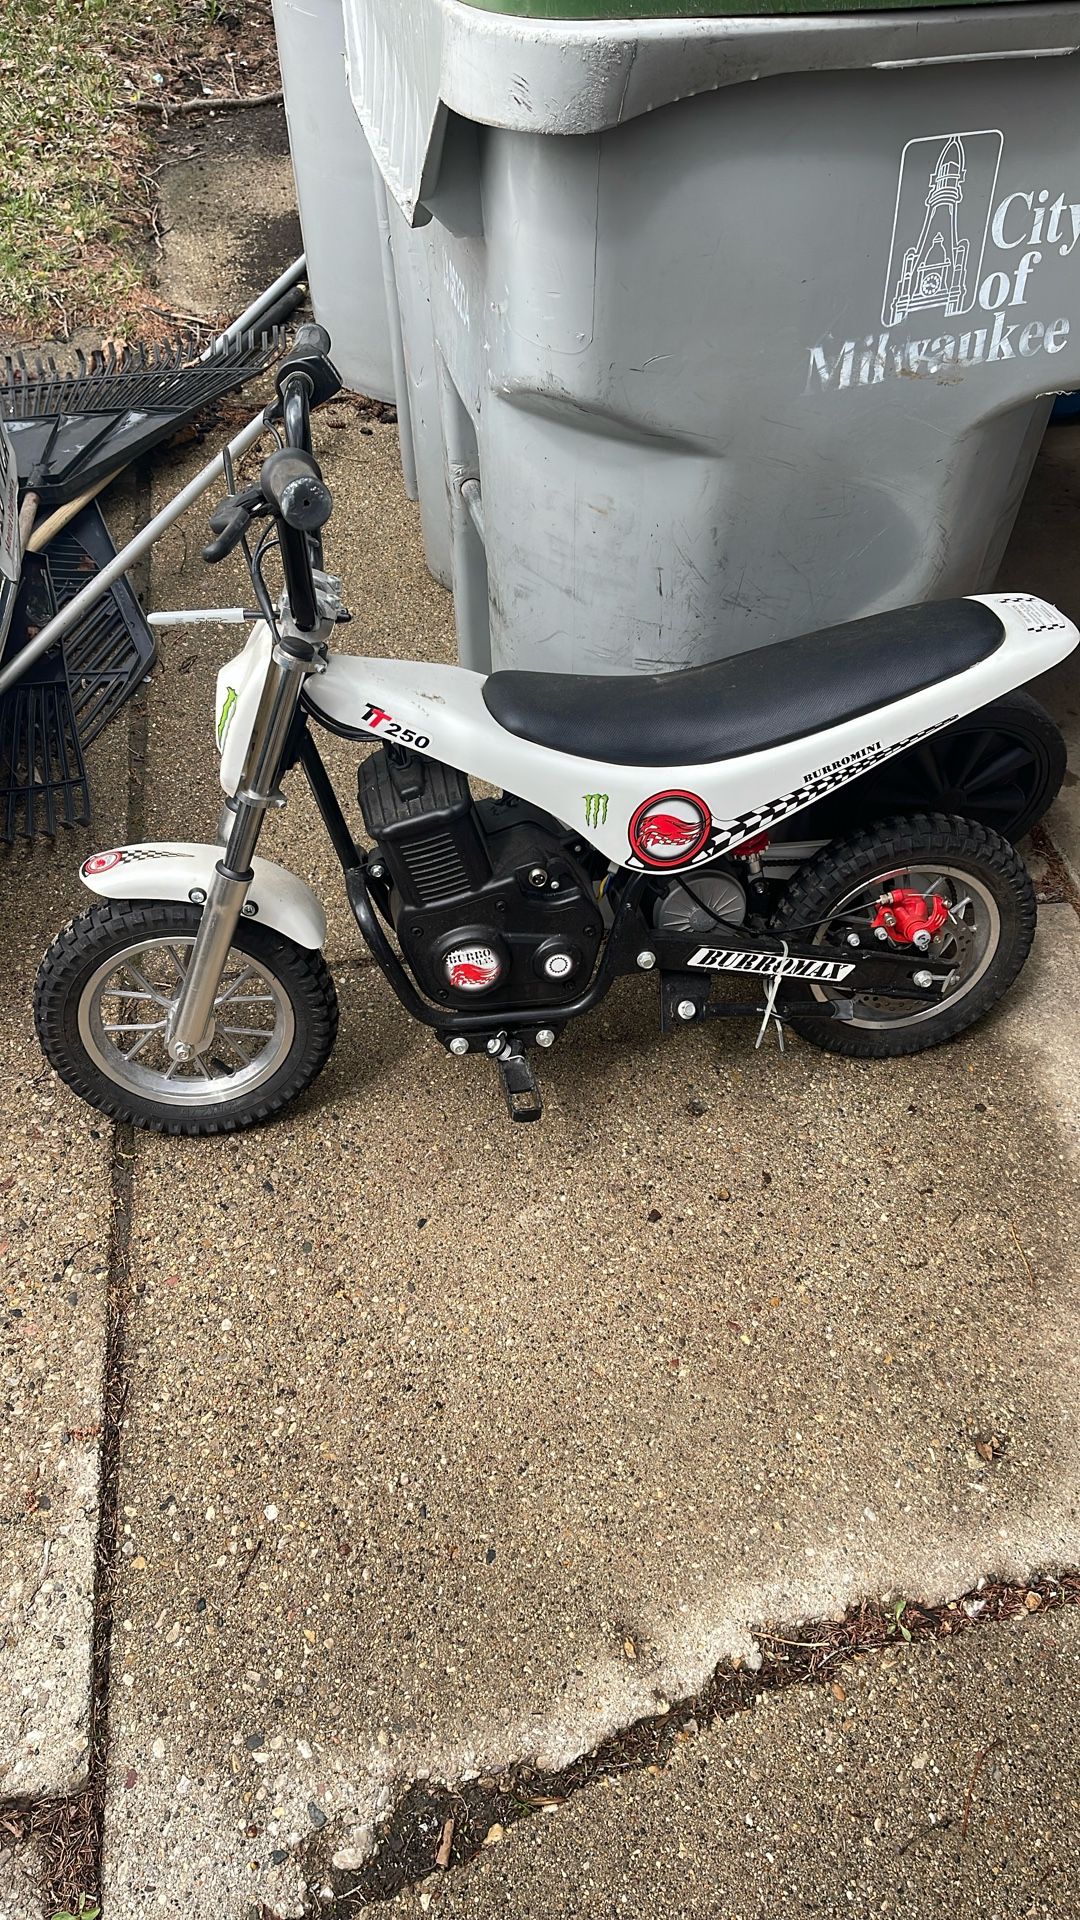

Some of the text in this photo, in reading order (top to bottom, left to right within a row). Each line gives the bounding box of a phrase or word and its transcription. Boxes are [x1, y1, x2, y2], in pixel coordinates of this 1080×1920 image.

[991, 189, 1080, 255] City
[978, 251, 1042, 310] of
[361, 702, 430, 749] TT 250
[803, 741, 882, 783] BURROMINI
[697, 949, 849, 980] BURROMAX
